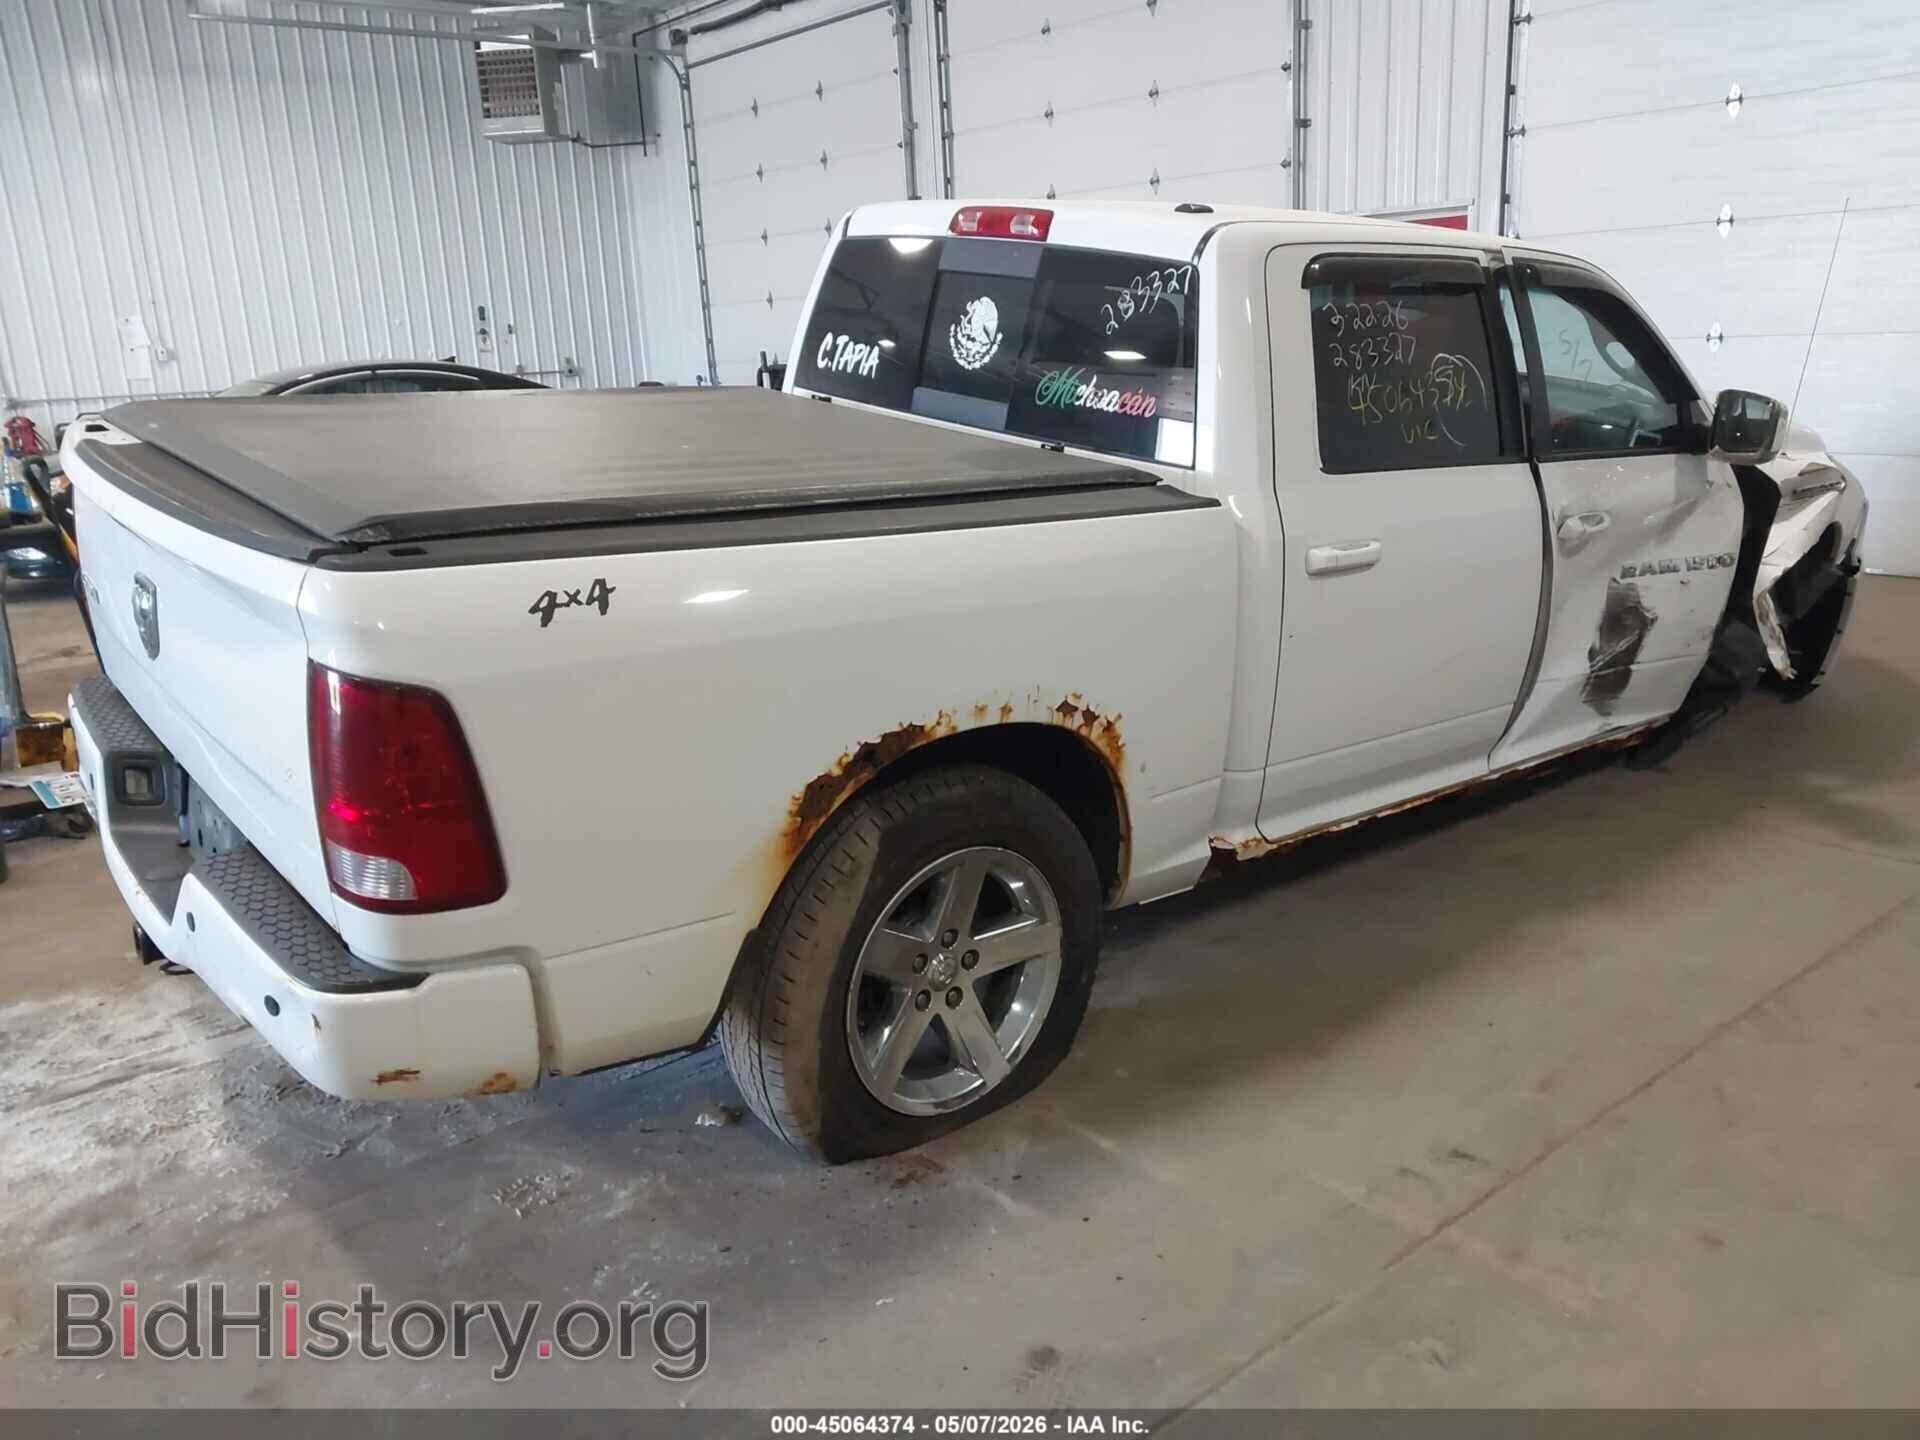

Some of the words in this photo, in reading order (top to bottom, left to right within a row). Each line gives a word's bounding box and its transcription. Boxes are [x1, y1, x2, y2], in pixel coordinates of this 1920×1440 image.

[1327, 331, 1417, 370] 283327
[1033, 365, 1159, 419] Michoacán
[1619, 558, 1682, 580] RAM
